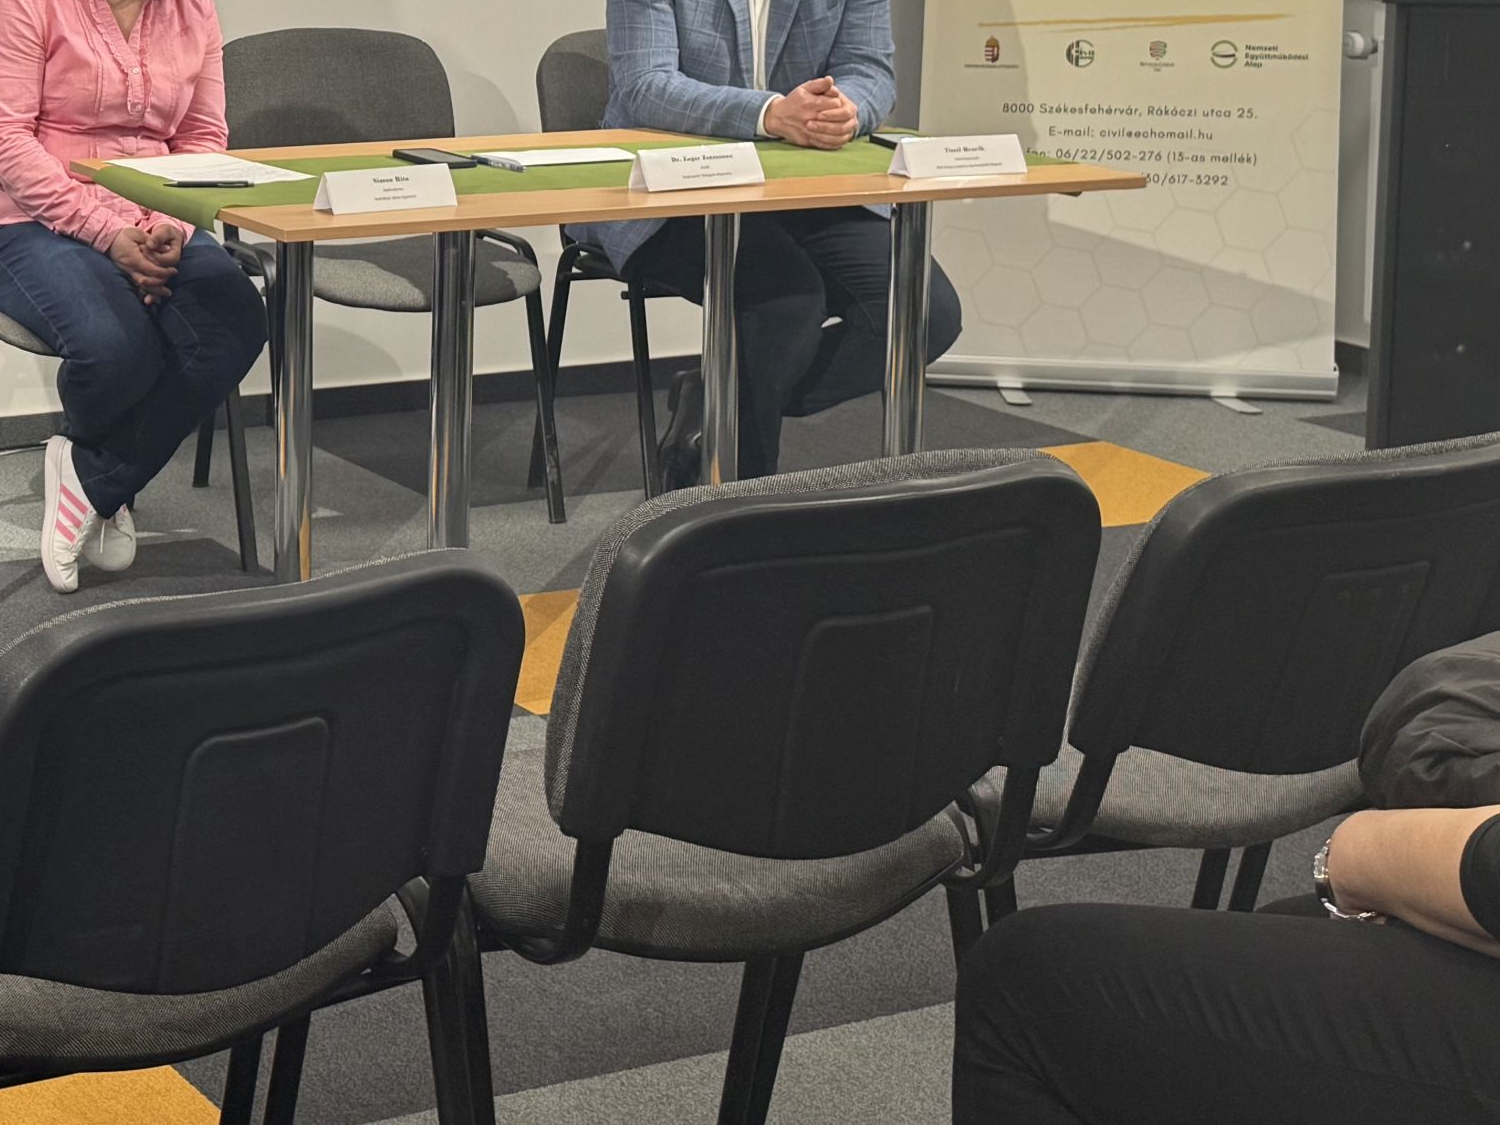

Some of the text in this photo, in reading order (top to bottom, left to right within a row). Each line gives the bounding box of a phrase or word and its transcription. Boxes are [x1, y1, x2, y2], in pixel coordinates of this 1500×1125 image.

[1002, 103, 1258, 119] 8000 Székesfehérvár, Rákóczi utca 25.
[1048, 125, 1094, 138] E-mail:
[1055, 148, 1162, 162] 06/22/502-276
[1211, 152, 1258, 167] mellék)
